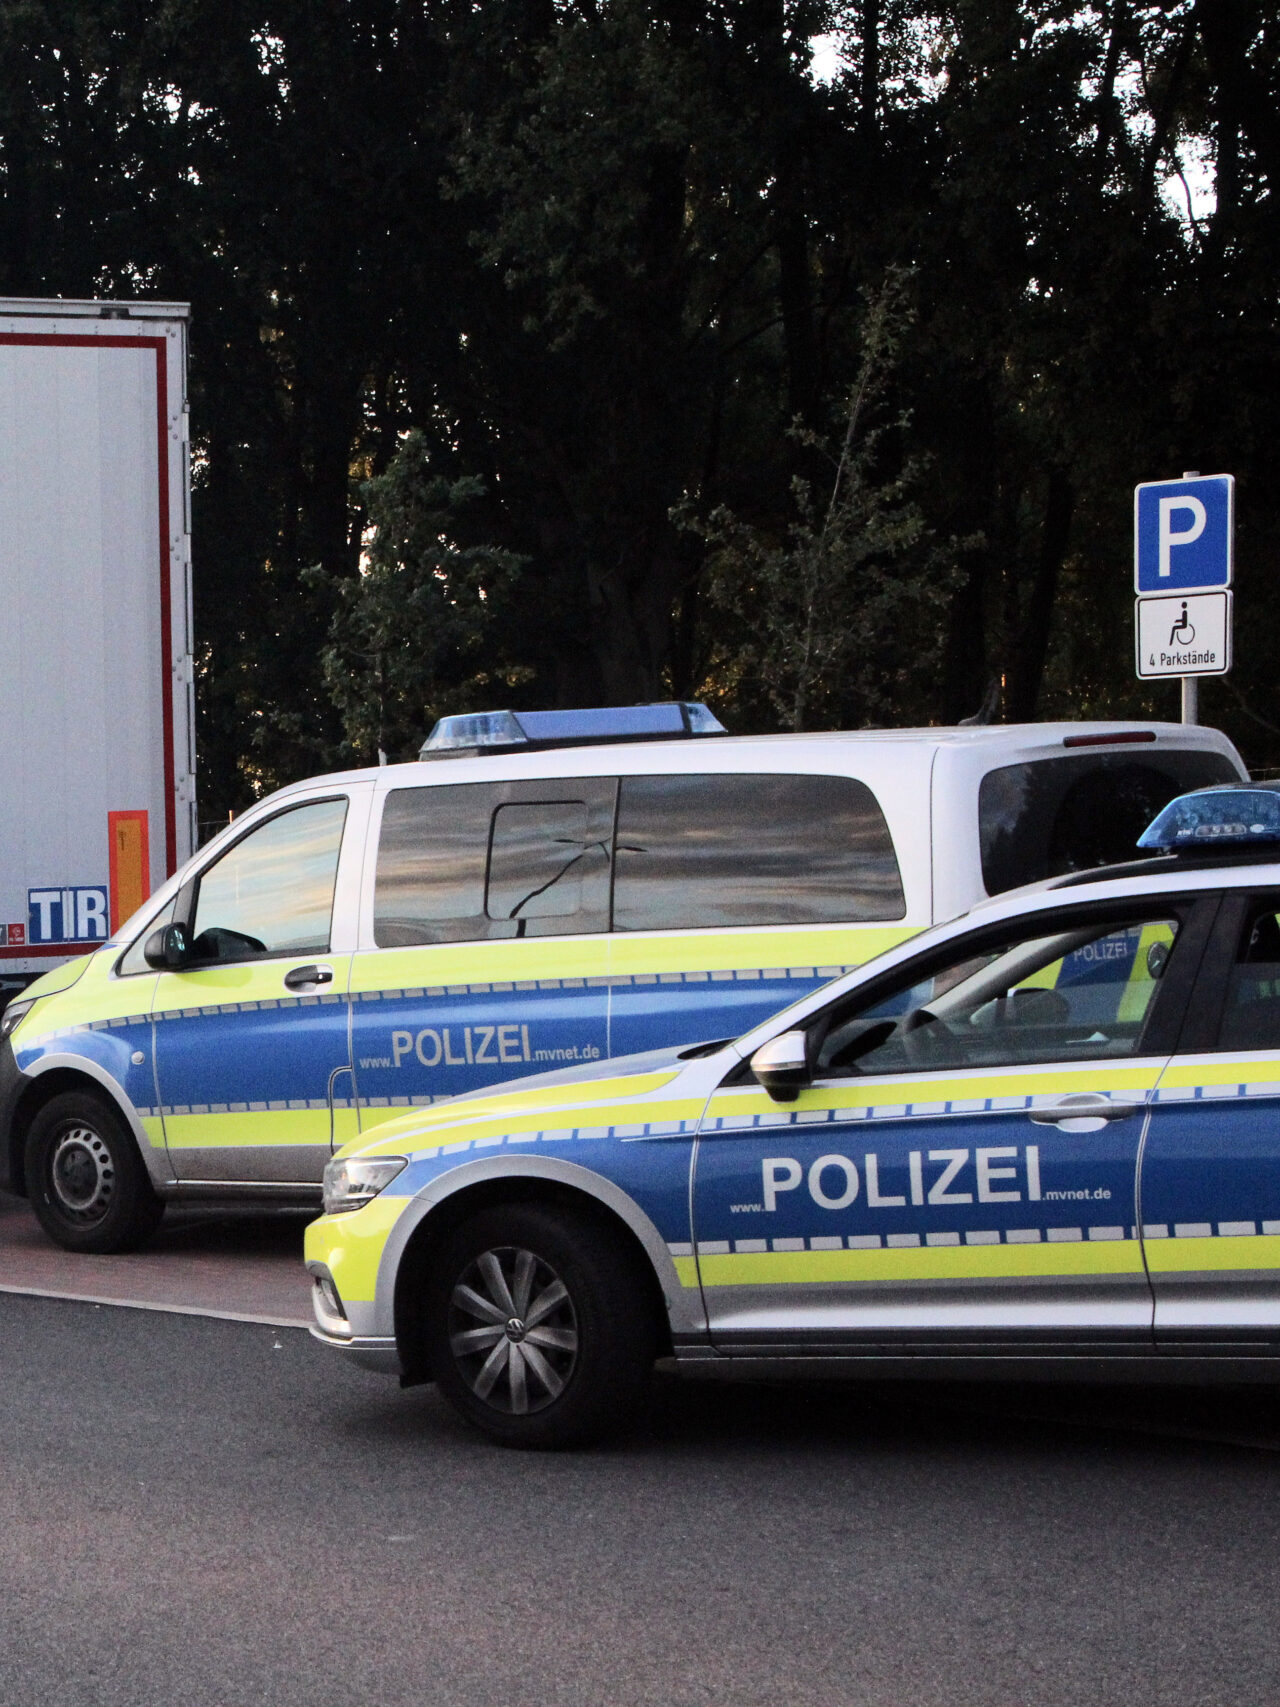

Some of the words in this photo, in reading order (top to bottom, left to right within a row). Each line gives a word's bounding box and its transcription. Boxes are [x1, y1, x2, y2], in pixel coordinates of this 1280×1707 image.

[1159, 495, 1207, 577] P
[1149, 653, 1156, 667] 4
[1160, 650, 1216, 666] Parkstände
[30, 891, 106, 940] TIR
[1073, 942, 1128, 961] POLIZEI
[730, 1145, 1111, 1212] www.POLIZEI.mvnet.de
